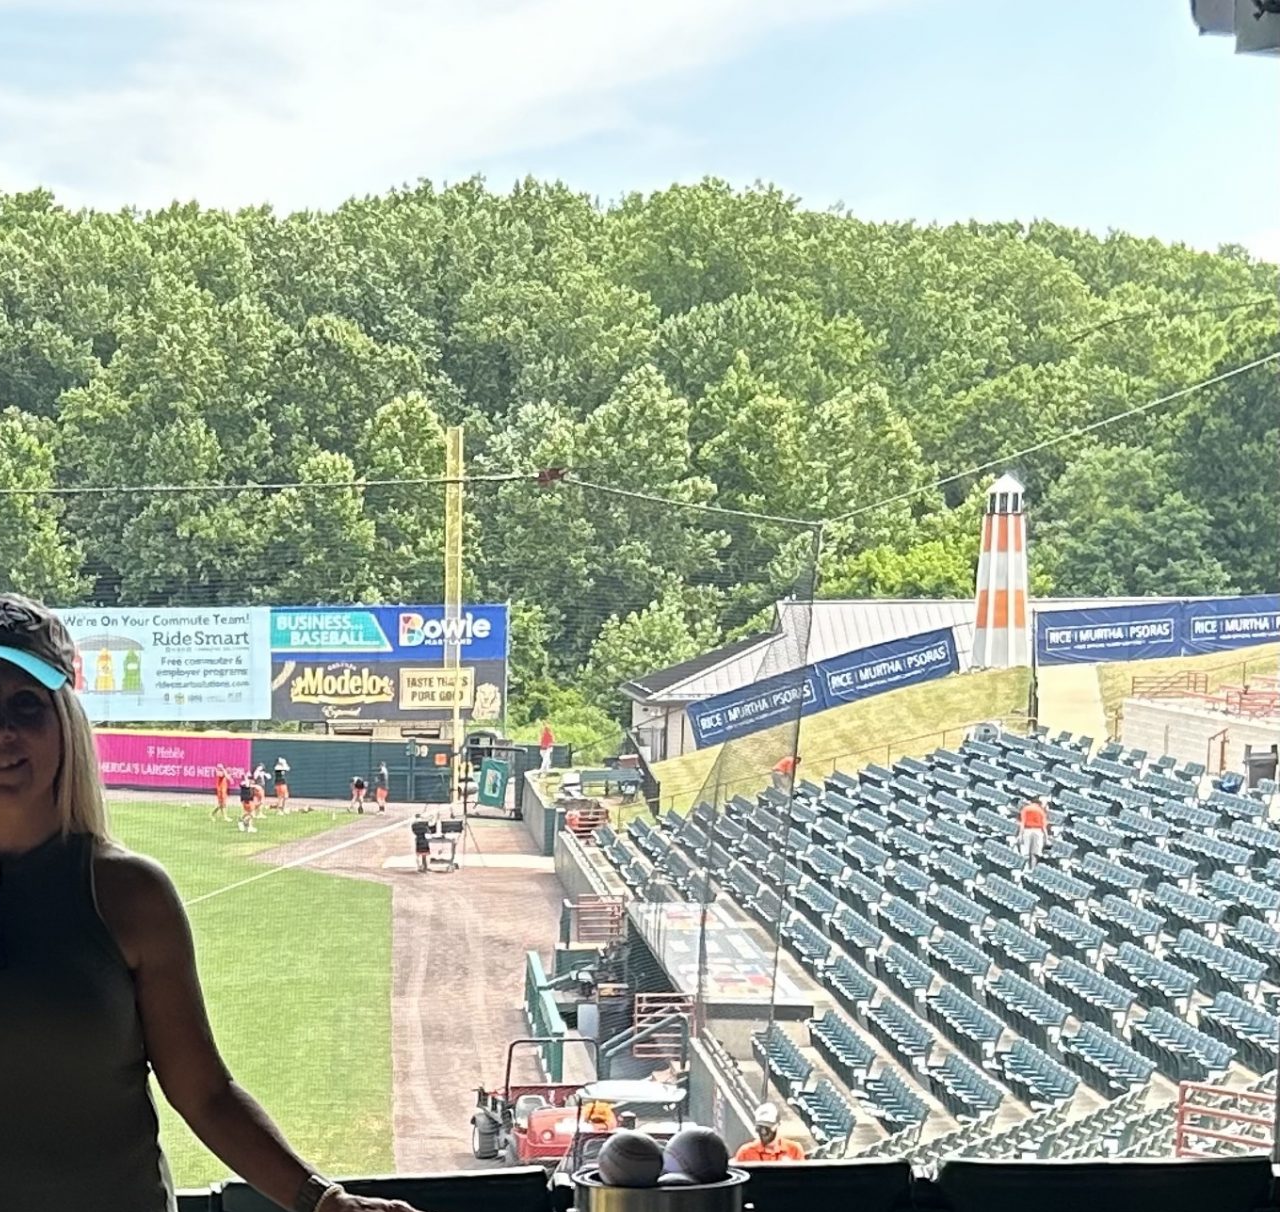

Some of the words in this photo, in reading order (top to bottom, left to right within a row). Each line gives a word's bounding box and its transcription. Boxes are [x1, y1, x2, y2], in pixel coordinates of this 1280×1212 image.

[64, 615, 98, 627] We're
[101, 615, 119, 627] On
[120, 615, 150, 627] Your
[152, 614, 210, 627] Commute
[213, 614, 250, 625] Team!
[399, 612, 492, 646] Bowie
[1194, 619, 1217, 633] RICE
[1225, 615, 1269, 632] MURTHA
[1049, 631, 1071, 644] RICE
[1079, 628, 1124, 642] MURTHA
[1129, 623, 1170, 638] PSORAS
[161, 656, 183, 666] Free
[185, 656, 233, 666] commuter
[830, 670, 853, 690] RICE
[858, 661, 903, 682] MURTHA
[906, 645, 946, 669] PSORAS
[156, 667, 200, 679] employer
[203, 668, 249, 679] programs
[302, 667, 383, 696] Modelo
[406, 677, 434, 688] TASTE
[411, 690, 436, 702] PURE
[700, 713, 723, 731] RICE
[727, 698, 769, 723] MURTHA
[773, 684, 812, 708] PSORAS
